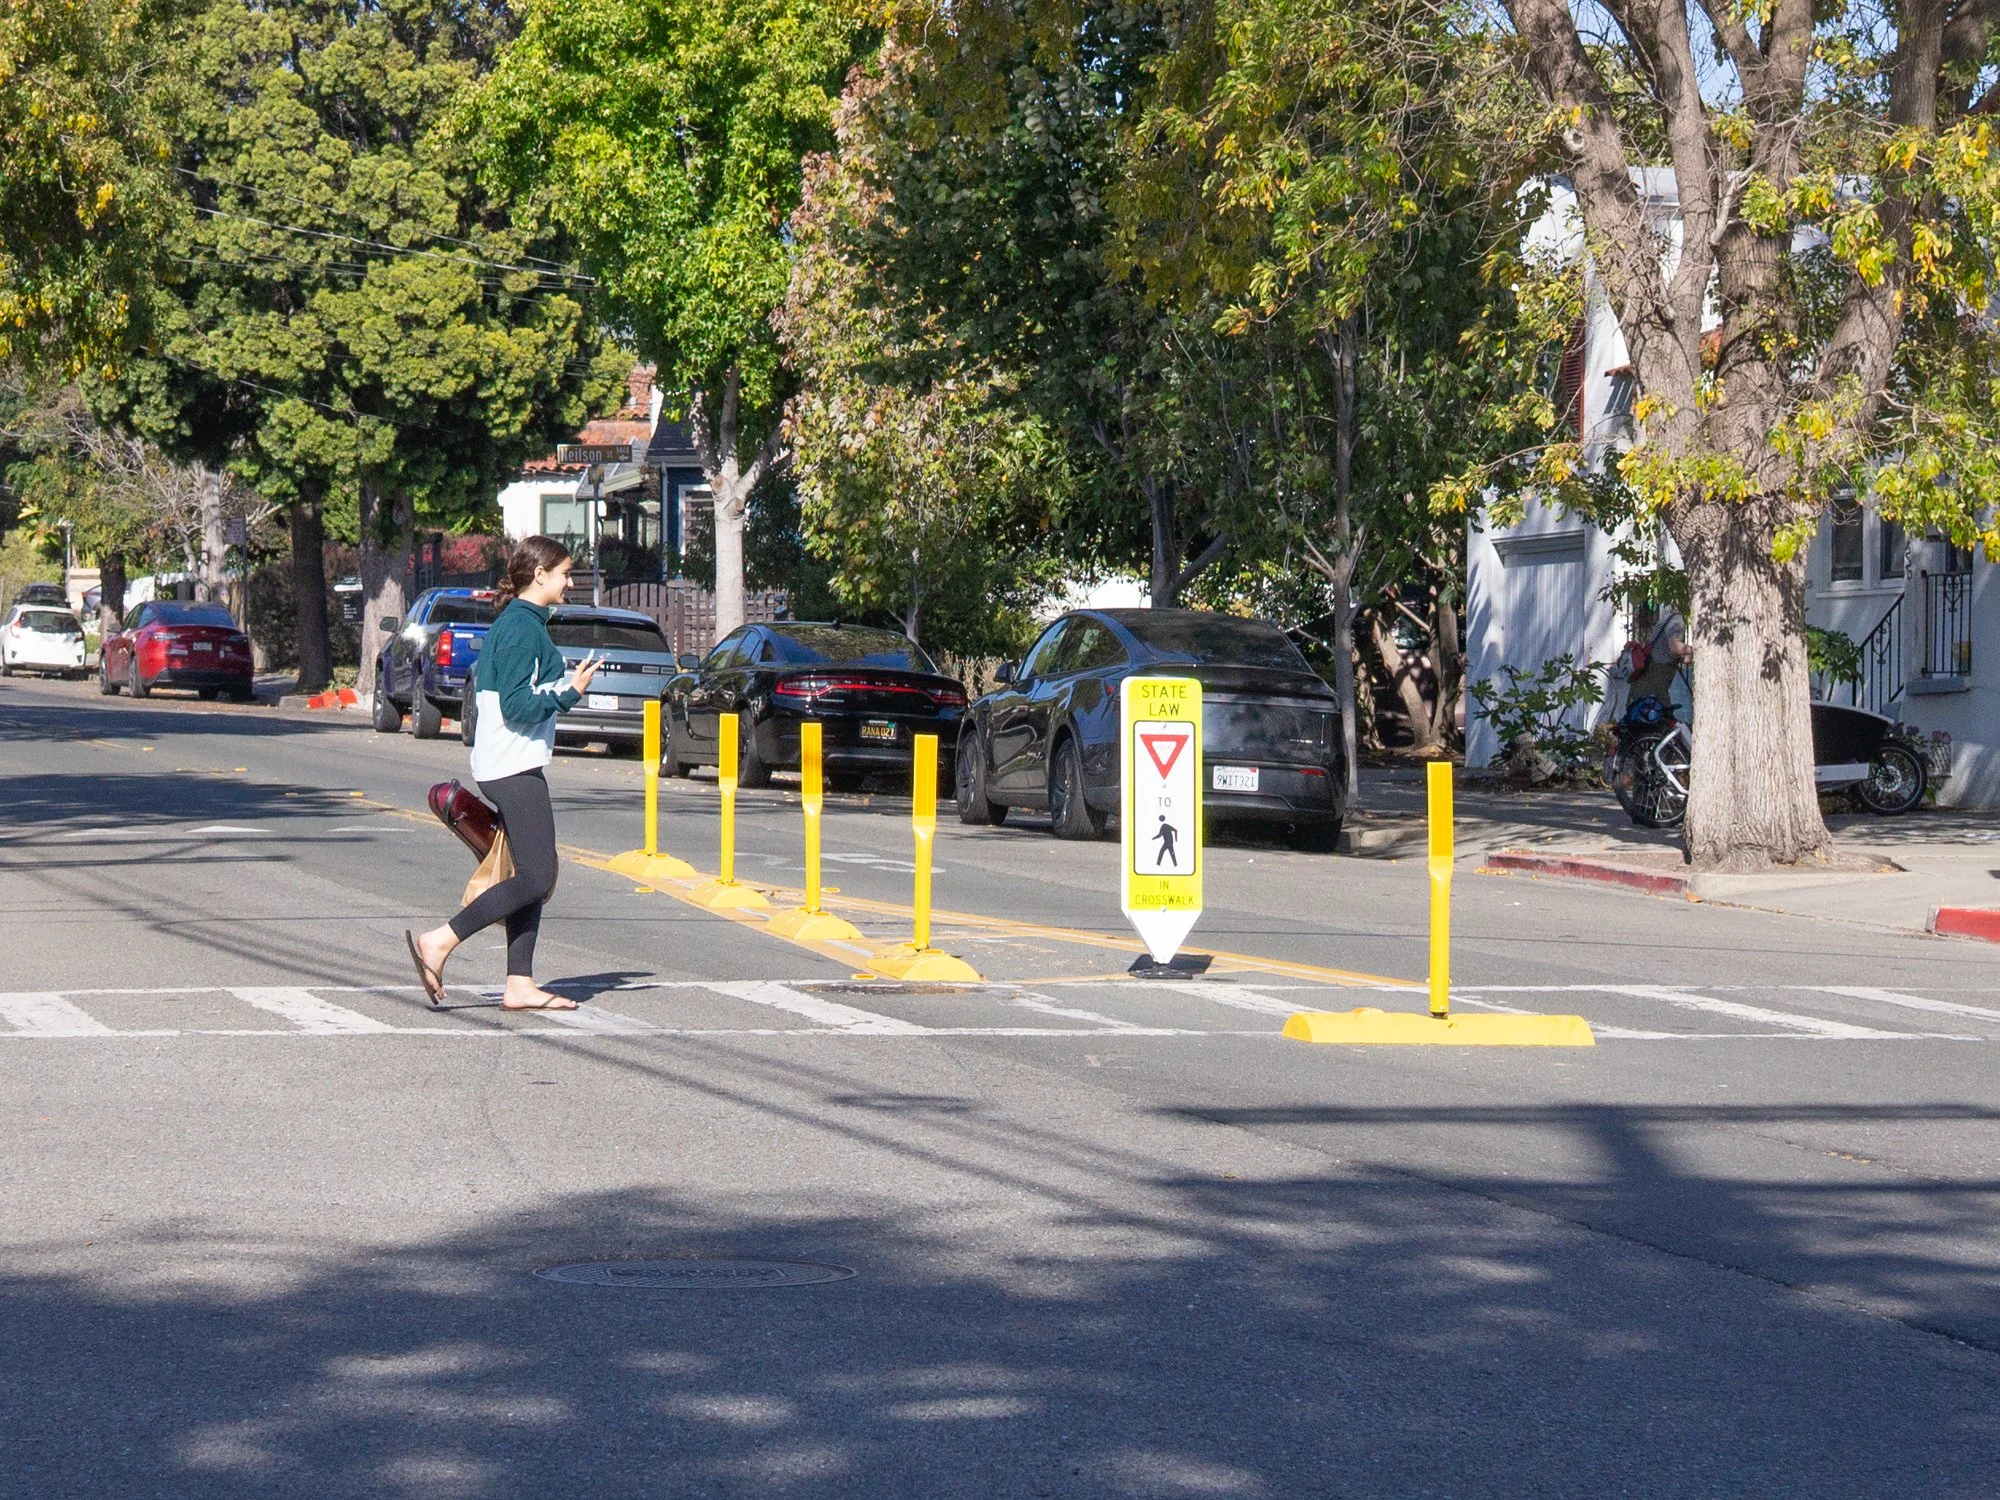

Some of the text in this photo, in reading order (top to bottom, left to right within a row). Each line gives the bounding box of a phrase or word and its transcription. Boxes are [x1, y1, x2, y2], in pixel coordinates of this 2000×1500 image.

[560, 447, 602, 462] Neilson
[1142, 684, 1188, 698] STATE
[1149, 703, 1179, 716] LAW
[1157, 797, 1172, 807] TO
[1159, 880, 1170, 891] IN
[1135, 894, 1194, 905] CROSSWALK
